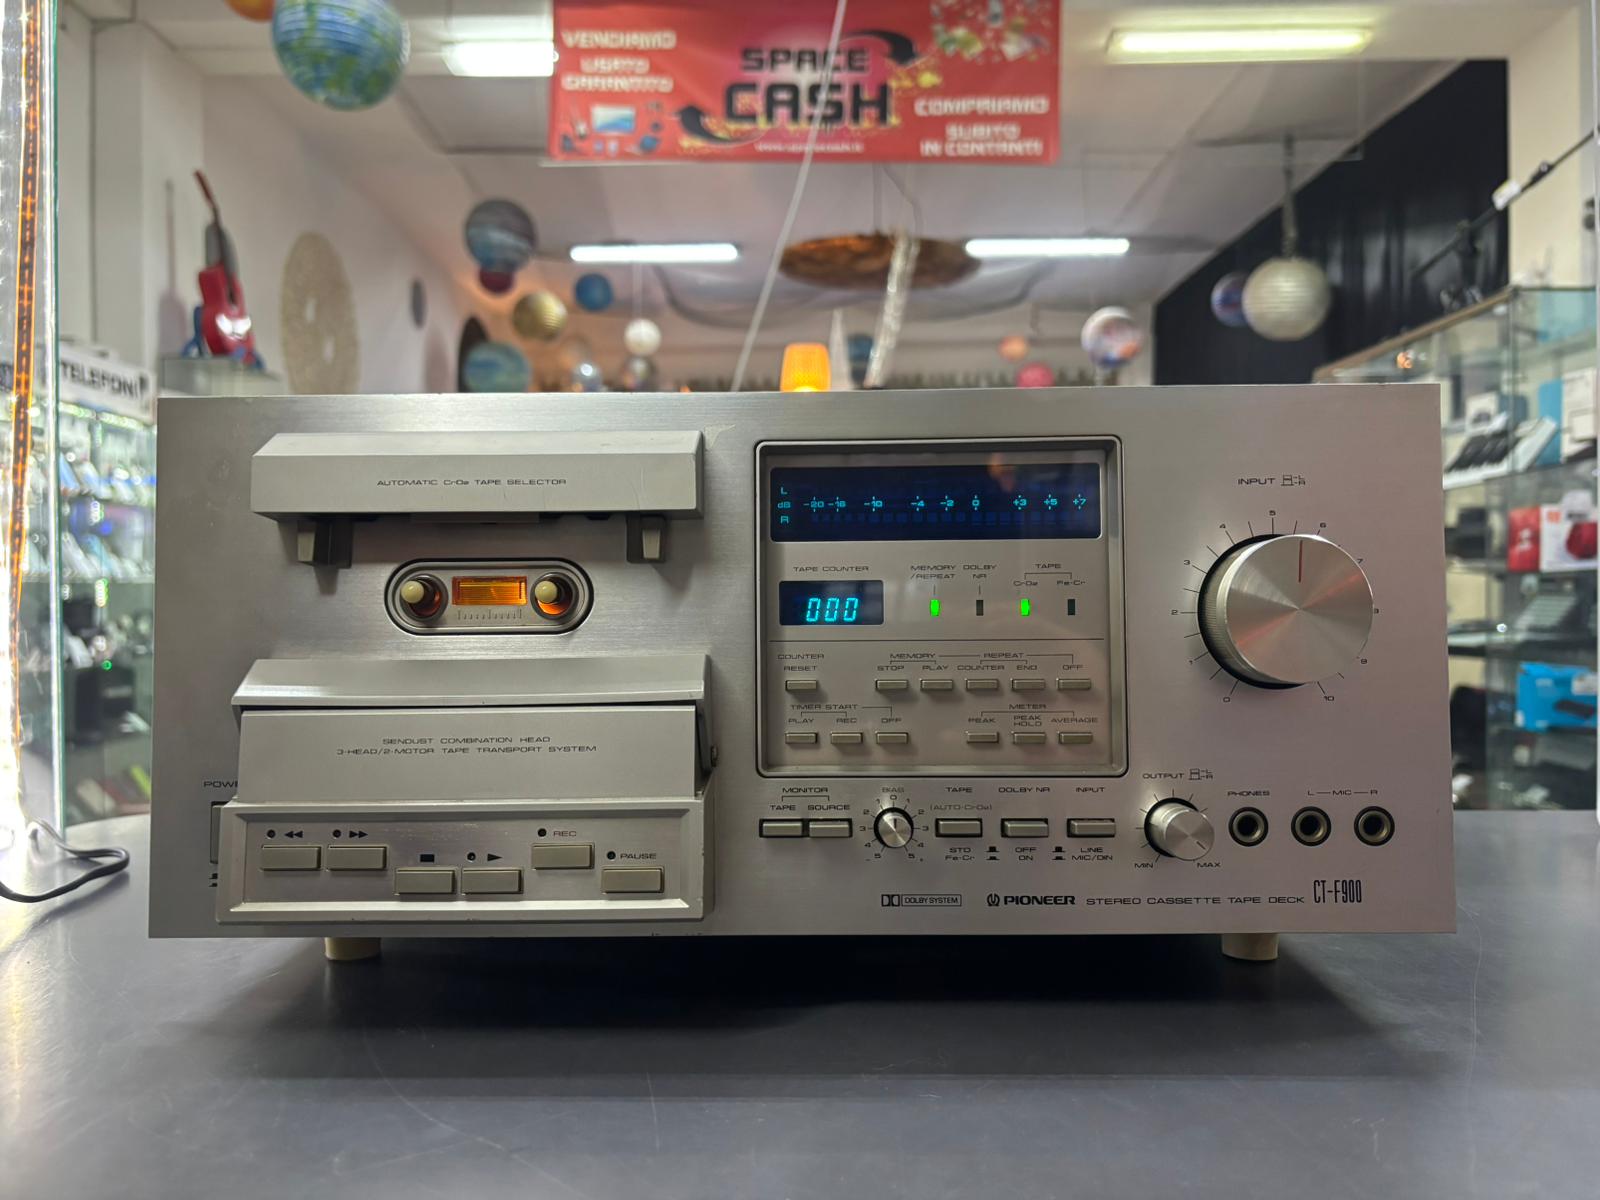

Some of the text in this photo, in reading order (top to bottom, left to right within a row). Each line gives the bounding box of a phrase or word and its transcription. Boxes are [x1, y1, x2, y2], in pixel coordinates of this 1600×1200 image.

[741, 47, 870, 73] SPACE
[725, 83, 890, 126] CASH
[377, 478, 439, 486] AUTOMATIC
[474, 478, 502, 486] TAPE
[506, 477, 568, 486] SELECTOR
[1237, 478, 1276, 486] INPUT
[780, 486, 788, 495] L
[777, 500, 792, 510] dB
[863, 500, 883, 509] -10
[910, 499, 925, 508] -4
[1012, 498, 1027, 507] +3
[1043, 498, 1058, 506] +5
[1072, 498, 1087, 506] +7
[780, 515, 790, 525] R
[806, 597, 859, 622] 000
[548, 745, 597, 753] SYSTEM
[1142, 772, 1185, 780] OUTPUT
[620, 852, 657, 860] PAUSE
[1003, 879, 1363, 906] PIONEER STEREO CASSETTE TAPE DECK CT-F900
[904, 896, 959, 904] DOLBY SYSTEM
